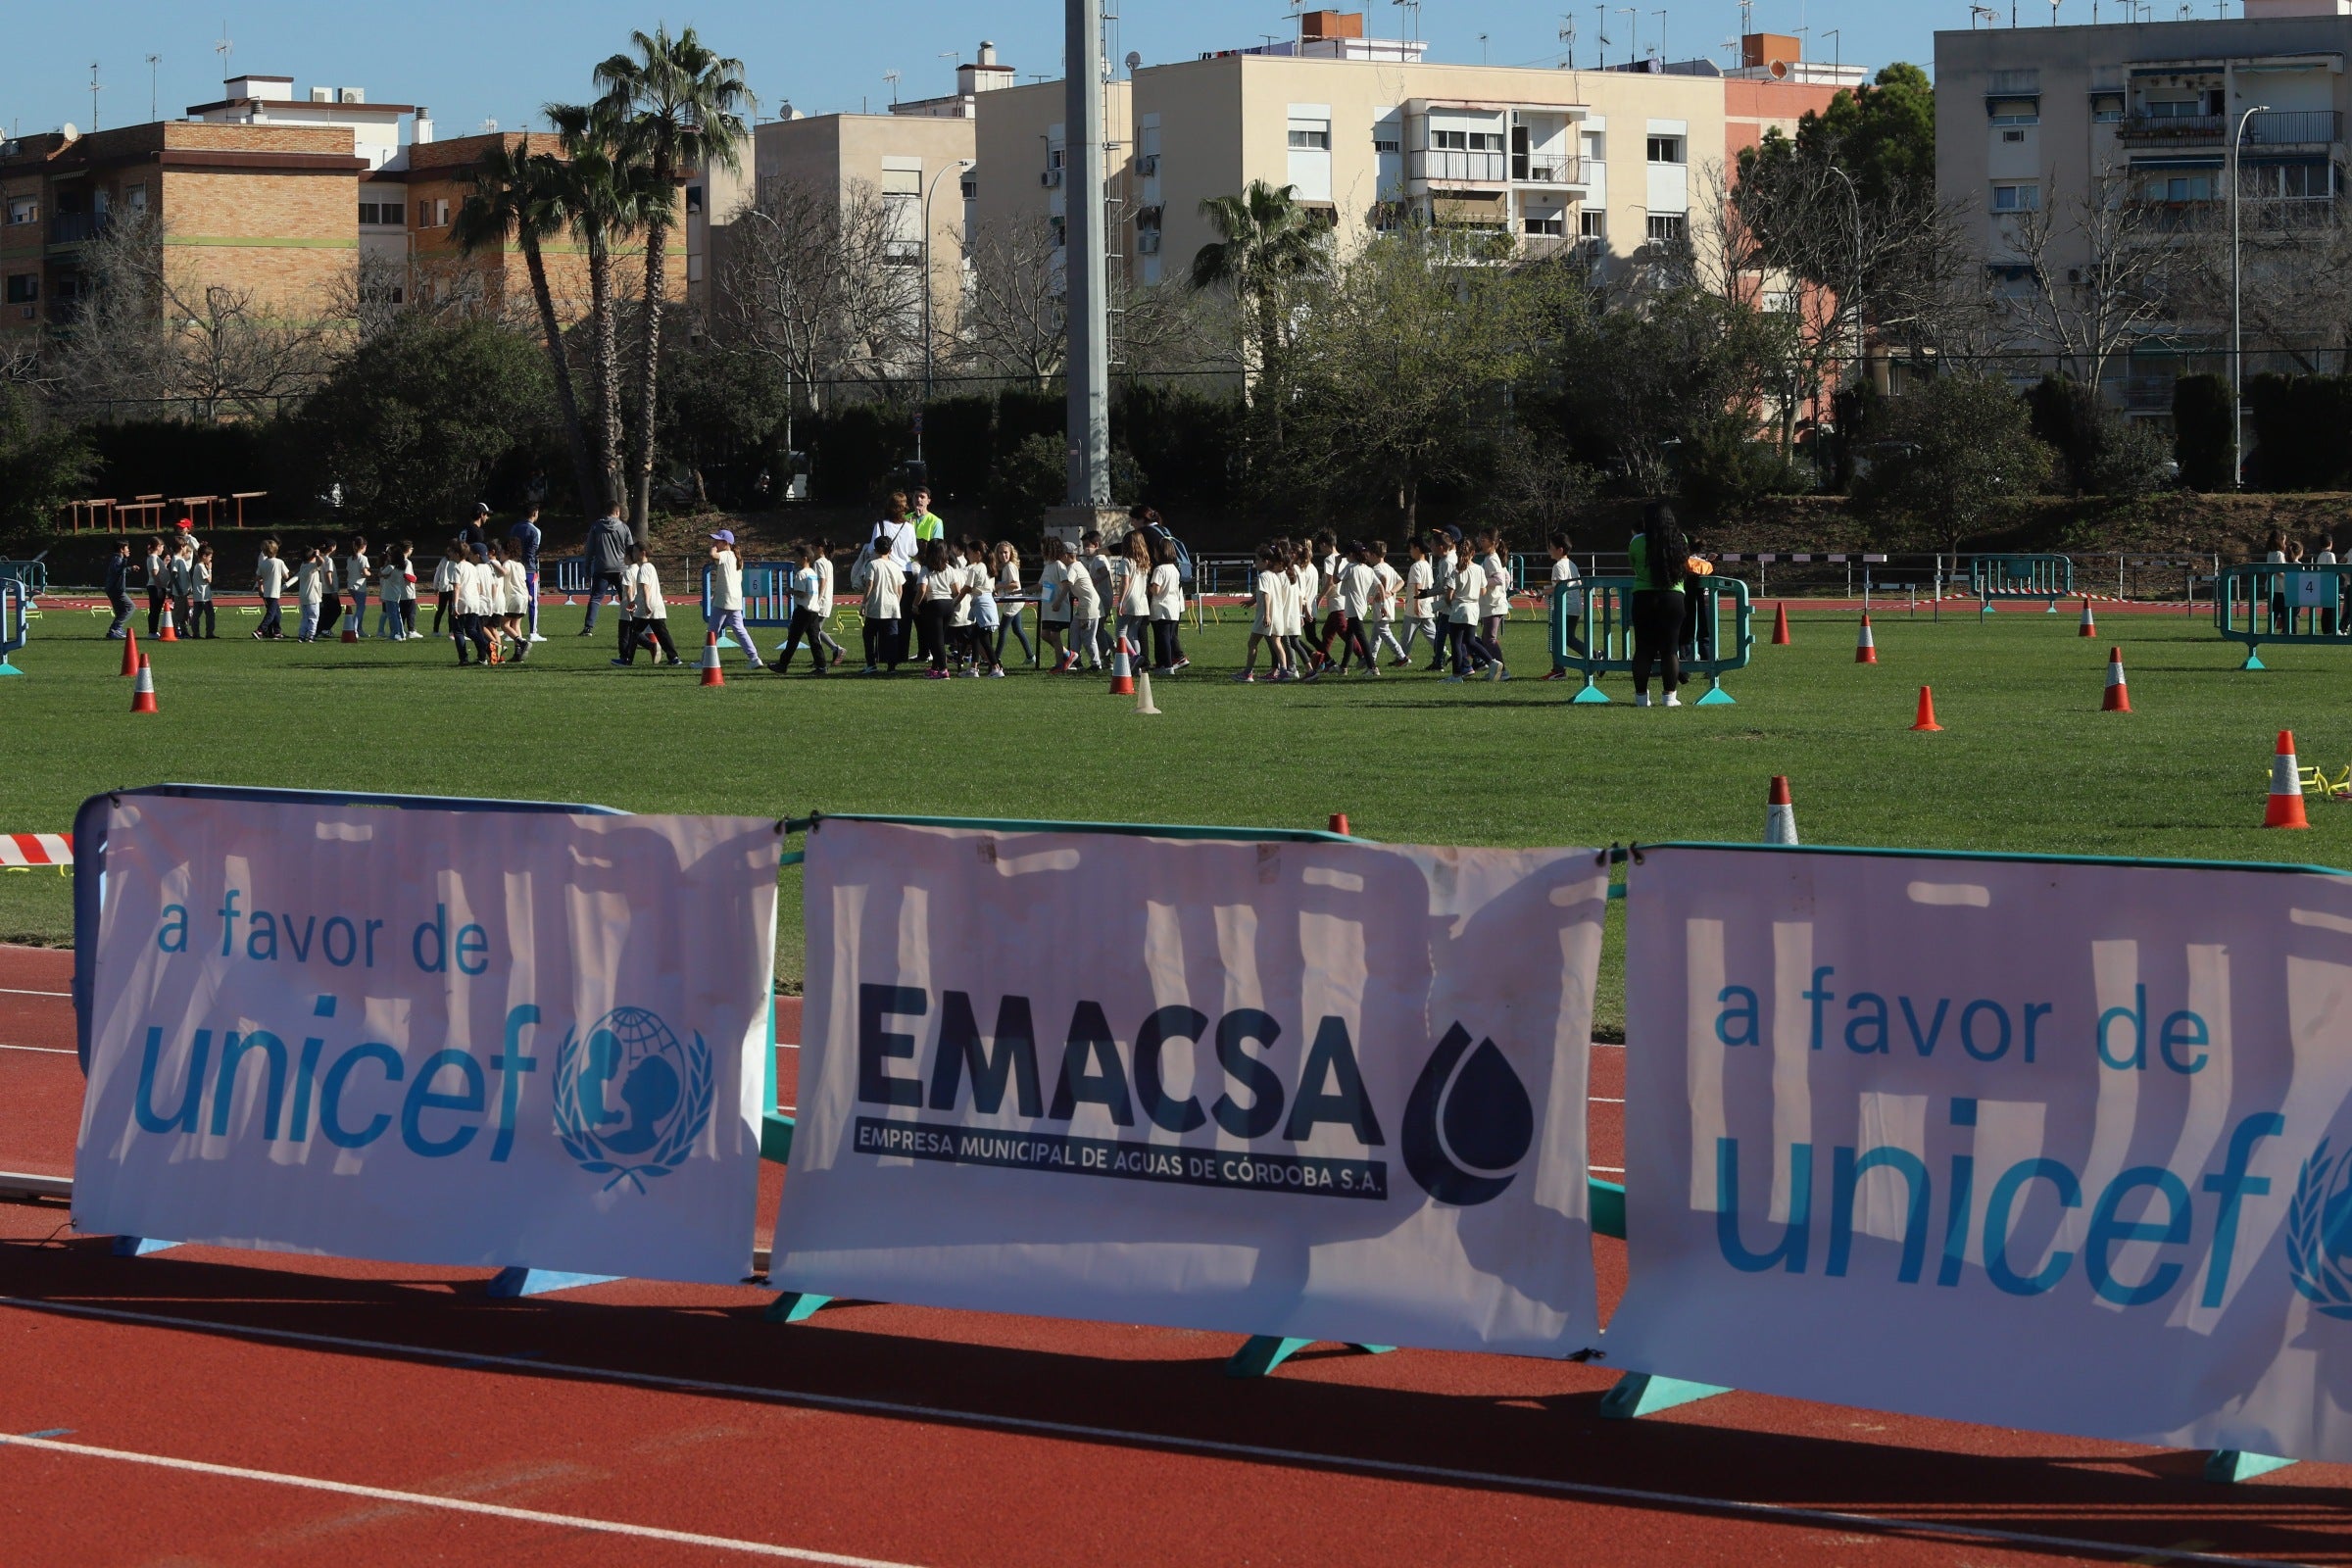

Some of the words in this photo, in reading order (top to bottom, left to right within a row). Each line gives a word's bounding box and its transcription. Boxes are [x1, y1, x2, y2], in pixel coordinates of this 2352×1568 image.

[753, 579, 759, 590] 6
[2305, 580, 2314, 593] 4
[158, 904, 187, 954] a
[218, 890, 383, 967] favor
[413, 903, 490, 975] de
[858, 983, 1387, 1147] EMACSA
[1715, 984, 1760, 1048] a
[1800, 965, 2053, 1064] favor
[2096, 983, 2211, 1076] de
[134, 994, 541, 1163] unicef
[858, 1125, 955, 1155] EMPRESA
[959, 1135, 1076, 1166] MUNICIPAL
[1081, 1146, 1108, 1170] DE
[1113, 1150, 1184, 1176] AGUAS
[1189, 1156, 1217, 1177] DE
[1222, 1155, 1334, 1189] CÓRDOBA
[1340, 1167, 1383, 1193] S.A.
[1715, 1096, 2286, 1310] unicef
